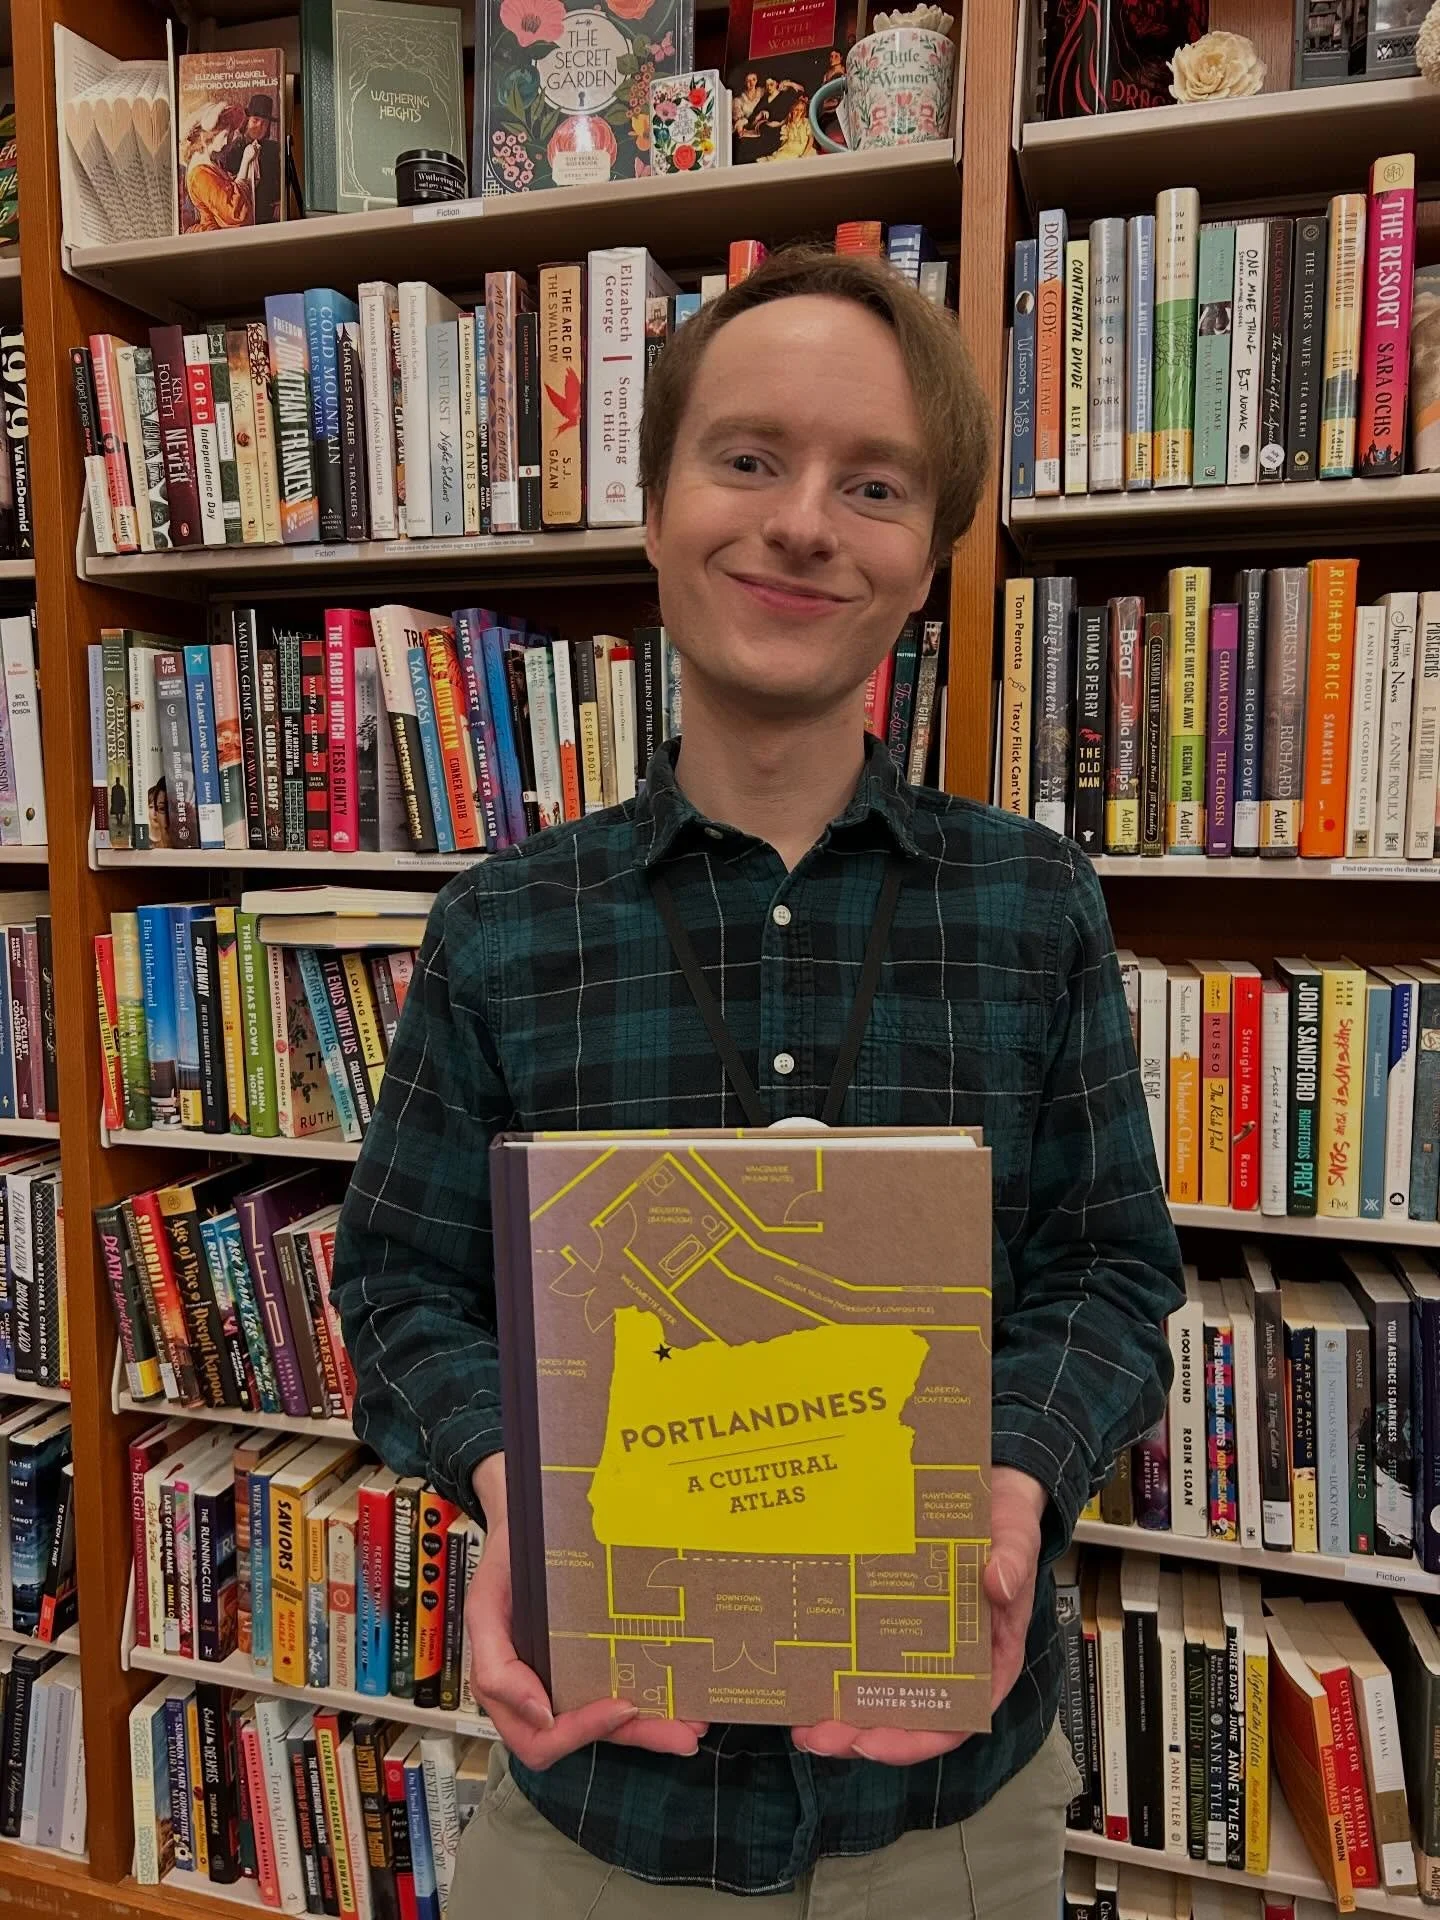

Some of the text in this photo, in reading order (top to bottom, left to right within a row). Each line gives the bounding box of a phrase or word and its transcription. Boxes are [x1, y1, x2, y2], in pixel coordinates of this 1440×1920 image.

[555, 49, 611, 69] SECRET
[568, 29, 598, 47] THE
[768, 34, 815, 50] WOMEN
[883, 49, 920, 68] Little
[195, 70, 267, 81] ELIZABETH GASKELL
[370, 90, 430, 108] WUTHERING
[547, 69, 617, 90] GARDEN
[877, 71, 930, 86] Women
[380, 104, 422, 123] HEIGHTS
[436, 207, 460, 217] Fiction
[1375, 196, 1405, 329] THE RESORT
[548, 274, 558, 363] THE SWALLOW
[562, 289, 572, 362] THE ARC OF
[603, 263, 632, 343] Elizabeth George
[1071, 259, 1084, 390] CONTINENTAL DIVIDE
[1094, 295, 1120, 305] HIGH
[1302, 251, 1315, 368] THE TIGER'S WIFE
[157, 363, 182, 420] KEN FOLLETT
[321, 306, 340, 465] COLD MOUNTAIN
[1102, 356, 1112, 365] IN
[1374, 343, 1395, 437] SARA OCHS
[191, 368, 208, 422] FORD
[603, 376, 630, 465] Something to Hide
[1093, 396, 1119, 406] DARK
[14, 444, 29, 533] Val McDermid
[201, 427, 216, 520] Independence Day
[465, 430, 475, 490] GAINES
[549, 449, 559, 489] GAZAN
[562, 457, 572, 480] S.J.
[314, 549, 336, 558] Fiction
[1014, 594, 1025, 670] Tom Perrotta
[1118, 629, 1137, 679] Bear
[1183, 574, 1197, 729] THE RICH PEOPLE HAVE GONE AWAY
[1245, 591, 1260, 671] Bewilderment
[1322, 566, 1345, 701] RICHARD PRICE
[329, 624, 346, 740] THE RABBIT HUTCH
[459, 619, 479, 711] MERCY STREET
[1083, 616, 1100, 719] THOMAS PERRY
[1217, 650, 1230, 738] CHAIM POTOK
[332, 743, 347, 817] TESS GUNTY
[1079, 747, 1100, 759] THE
[1079, 761, 1100, 773] OLD
[1119, 702, 1133, 791] Julia Phillips
[1182, 745, 1193, 778] REGINA
[1278, 725, 1294, 797] RICHARD
[1320, 713, 1336, 786] SAMARITAN
[476, 738, 498, 837] JENNIFER HAIGH
[1078, 776, 1100, 788] MAN
[1215, 751, 1227, 826] THE CHOSEN
[1274, 809, 1287, 840] Adult
[241, 924, 259, 1056] THIS BIRD HAS FLOWN
[350, 972, 375, 1060] LOVING FRANK
[1211, 1018, 1220, 1073] RUSSO
[1241, 1028, 1253, 1110] Straight Man
[1296, 982, 1319, 1102] JOHN SANDFORD
[300, 1112, 334, 1128] RUTH
[1292, 1108, 1314, 1198] RIGHTEOUS PREY
[1240, 1154, 1251, 1188] Russo
[102, 1233, 123, 1282] DEATH
[136, 1214, 169, 1298] SHANGHAI
[172, 1219, 190, 1244] Age
[183, 1262, 199, 1289] Vice
[38, 1262, 47, 1360] MICHAEL CHABON
[1305, 1392, 1311, 1406] OF
[1387, 1320, 1397, 1443] YOUR ABSENCE IS DARKNESS
[620, 1386, 887, 1452] PORTLANDNESS
[687, 1454, 838, 1493] A CULTURAL
[729, 1486, 806, 1513] ATLAS
[1183, 1427, 1193, 1506] ROBIN SLOAN
[200, 1508, 212, 1603] THE RUNNING CLUB
[278, 1500, 293, 1573] SAVIORS
[394, 1497, 411, 1589] STRONGHOLD
[716, 1593, 761, 1602] DOWNTOWN
[1375, 1572, 1406, 1583] Fiction
[1068, 1636, 1081, 1680] HARRY
[1229, 1638, 1238, 1742] THREE DAYS JUNE
[857, 1686, 948, 1698] DAVID BANIS &
[857, 1698, 952, 1709] HUNTER SHOBE
[1338, 1679, 1360, 1772] CUTTING FOR
[1210, 1729, 1222, 1774] ANNE
[1331, 1707, 1343, 1751] STONE
[321, 1734, 343, 1841] ELIZABETH McCRACKEN
[1170, 1756, 1182, 1827] ANNE TYLER
[1228, 1749, 1240, 1842] ANNE TYLER
[1322, 1748, 1339, 1814] AFTERWARD
[1333, 1819, 1346, 1862] VAUDRIN
[1341, 1785, 1369, 1852] ABRAHAM VERGHESE
[338, 1859, 352, 1908] BOWLAWAY
